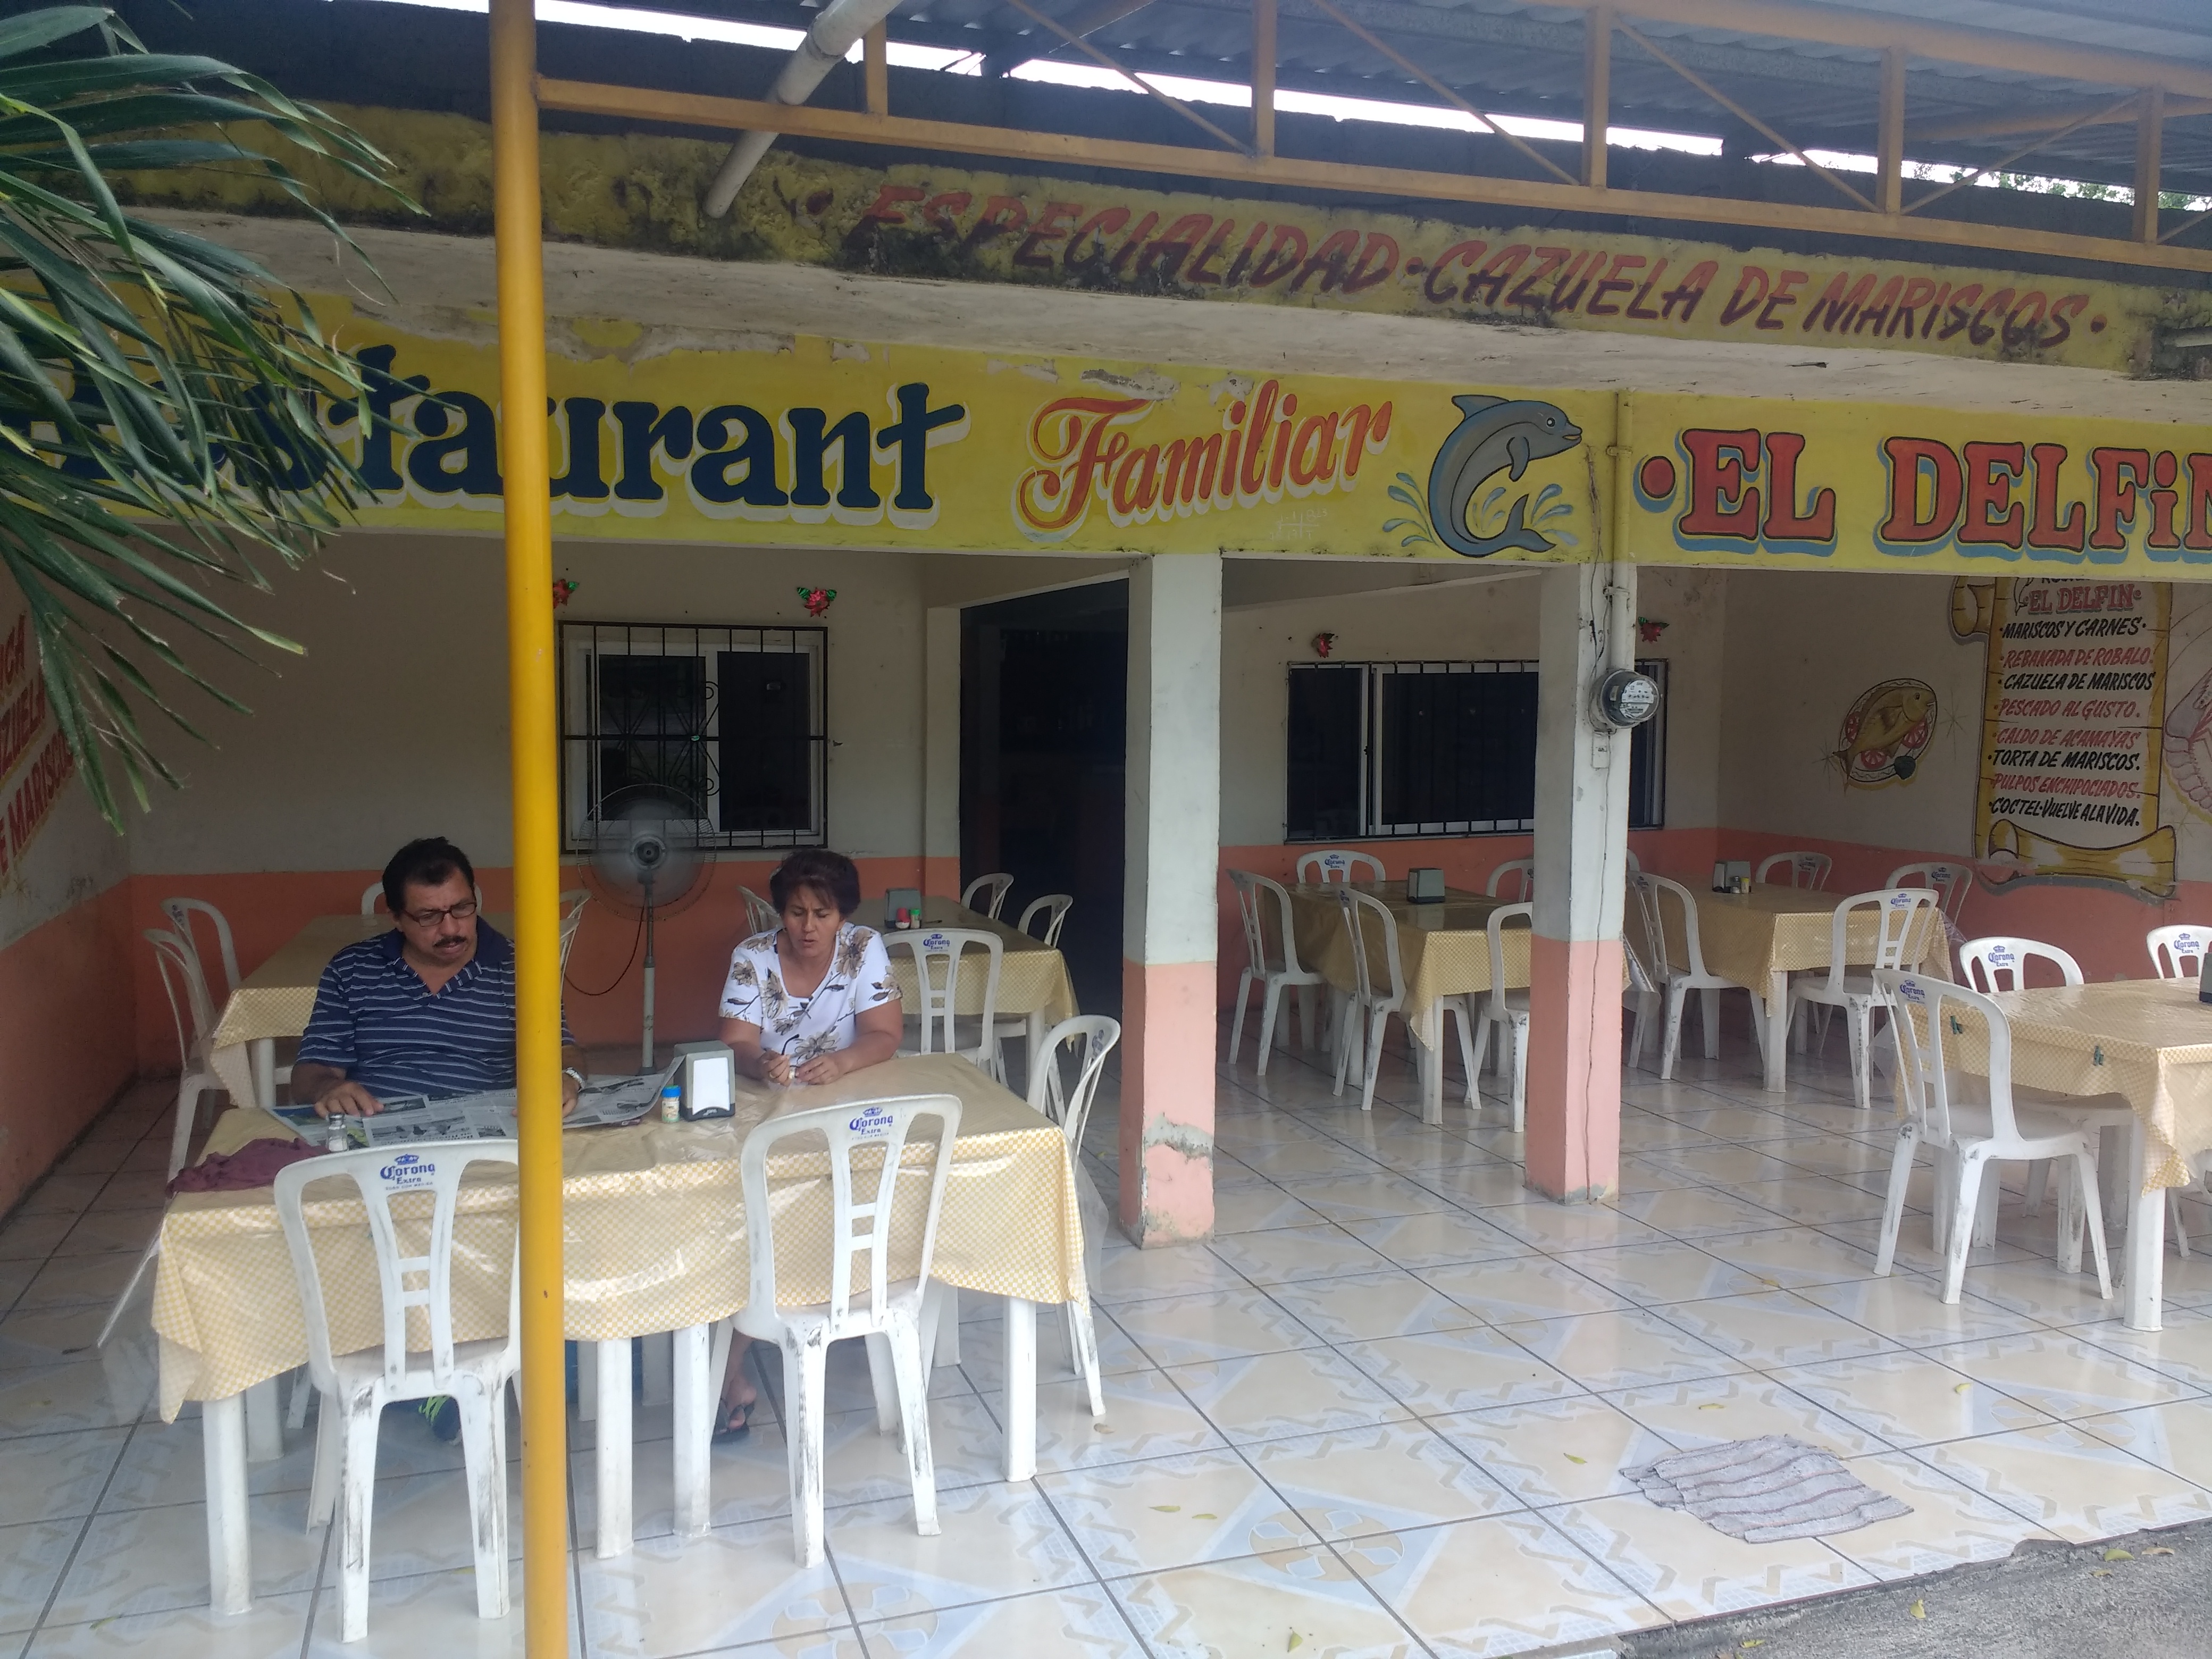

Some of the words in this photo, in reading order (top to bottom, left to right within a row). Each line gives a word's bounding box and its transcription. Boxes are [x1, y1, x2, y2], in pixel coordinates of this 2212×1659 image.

[843, 185, 1398, 294] ESPECIALIDAD
[1425, 240, 1718, 322] CAZUELA
[1720, 266, 1809, 331] DE
[1804, 272, 2089, 347] MARISCOS
[0, 325, 967, 524] taurant
[1019, 379, 1393, 529] Familiar
[1678, 428, 1837, 548] EL
[2029, 590, 2052, 614] EL
[2057, 584, 2134, 613] DELFIN
[2002, 619, 2065, 639] MARISCOS
[2065, 621, 2076, 638] Y
[2075, 616, 2143, 637] CARNES
[2004, 650, 2075, 668] REBANADA
[2074, 648, 2094, 666] DE
[2093, 647, 2153, 665] ROBALO.
[2004, 672, 2068, 690] CAZUELA
[2067, 673, 2088, 690] DE
[2087, 672, 2156, 690] MARISCOS
[1998, 698, 2062, 717] PESCADO
[2062, 700, 2082, 717] AL
[2081, 699, 2141, 720] GUSTO.
[1996, 727, 2040, 744] CALDO
[2039, 729, 2062, 745] DE
[2059, 729, 2141, 749] ACAMAYAS
[1993, 749, 2040, 766] TORTA
[2038, 751, 2062, 767] DE
[2061, 751, 2140, 770] MARISCOS.
[1992, 773, 2041, 792] PULPOS
[923, 939, 950, 947] Corona
[2174, 939, 2200, 950] Corona
[1988, 952, 2015, 963] Corona
[1899, 983, 1925, 996] Corona
[849, 1116, 893, 1132] Corona
[380, 1163, 435, 1181] Corona
